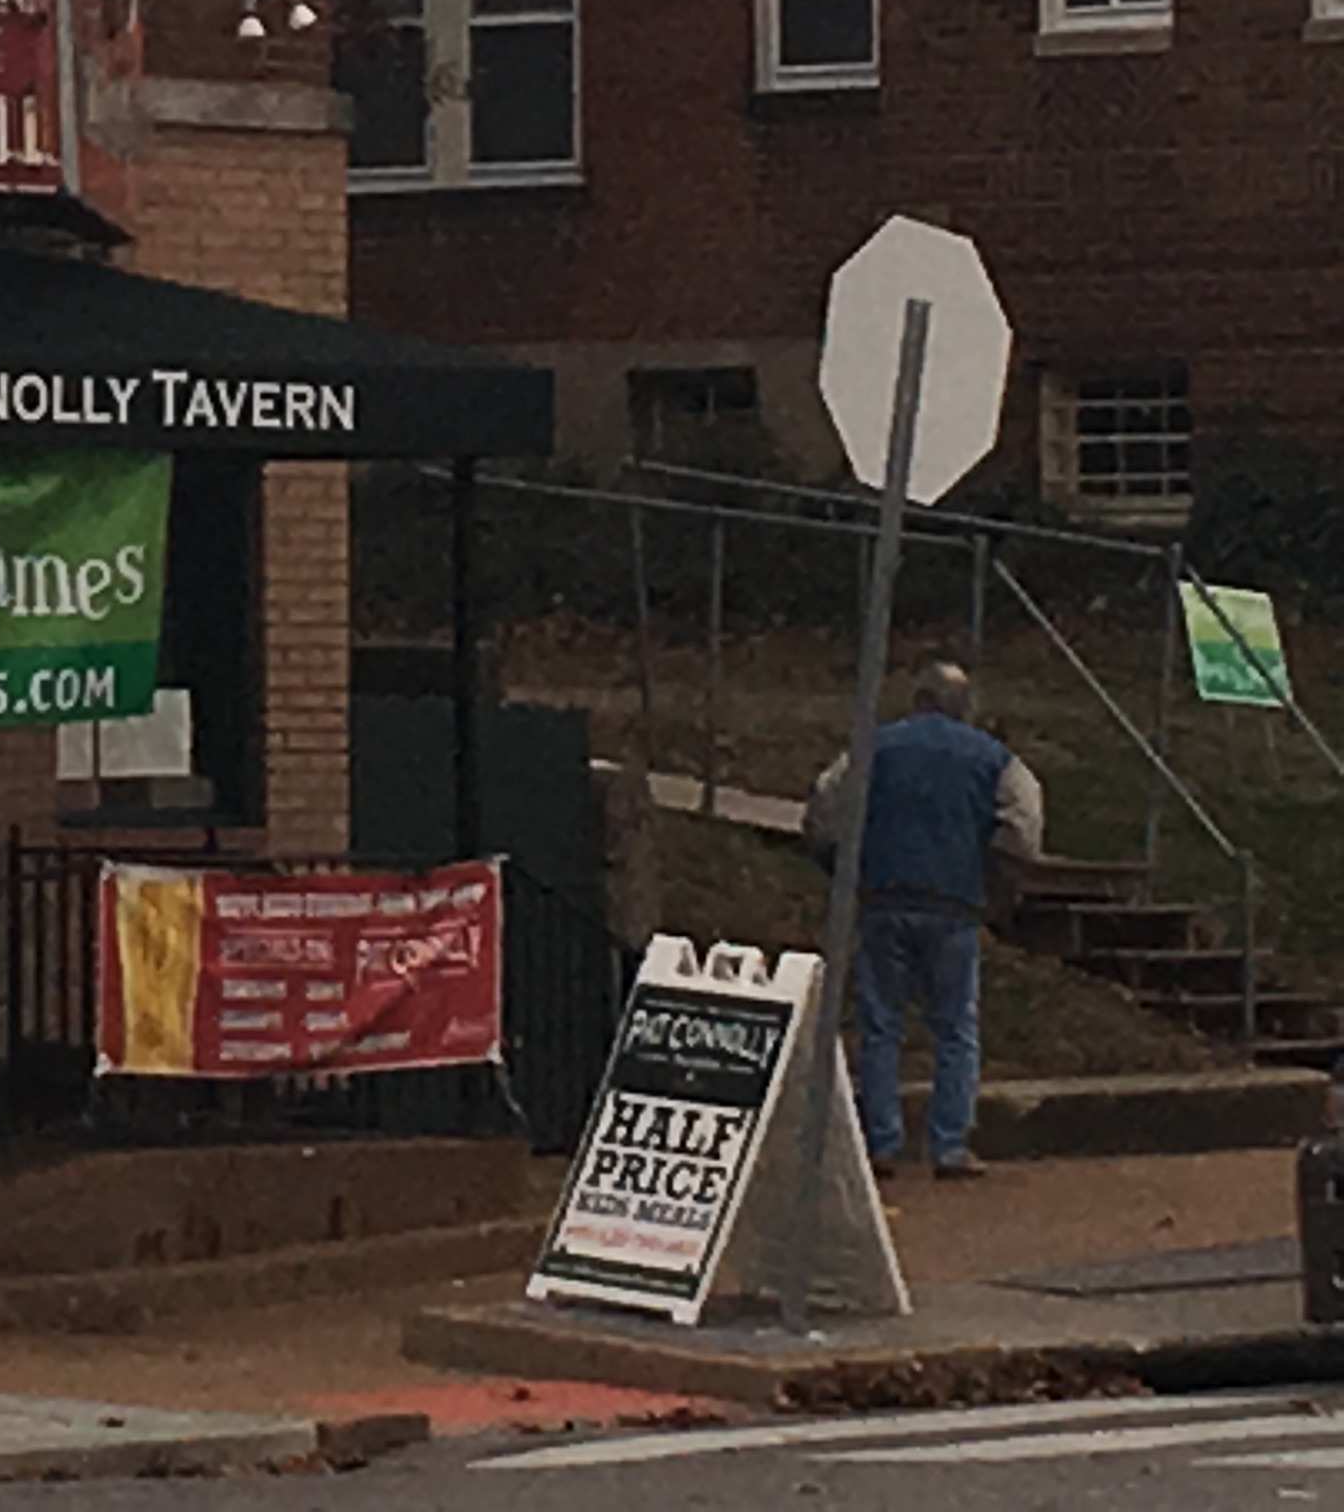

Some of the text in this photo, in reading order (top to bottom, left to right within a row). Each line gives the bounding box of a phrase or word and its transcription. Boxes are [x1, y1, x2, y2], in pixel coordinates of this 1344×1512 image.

[151, 368, 357, 433] TAVERN
[624, 1008, 781, 1070] PAT CONNOLLY
[600, 1099, 742, 1160] HALF
[586, 1150, 727, 1203] PRICE
